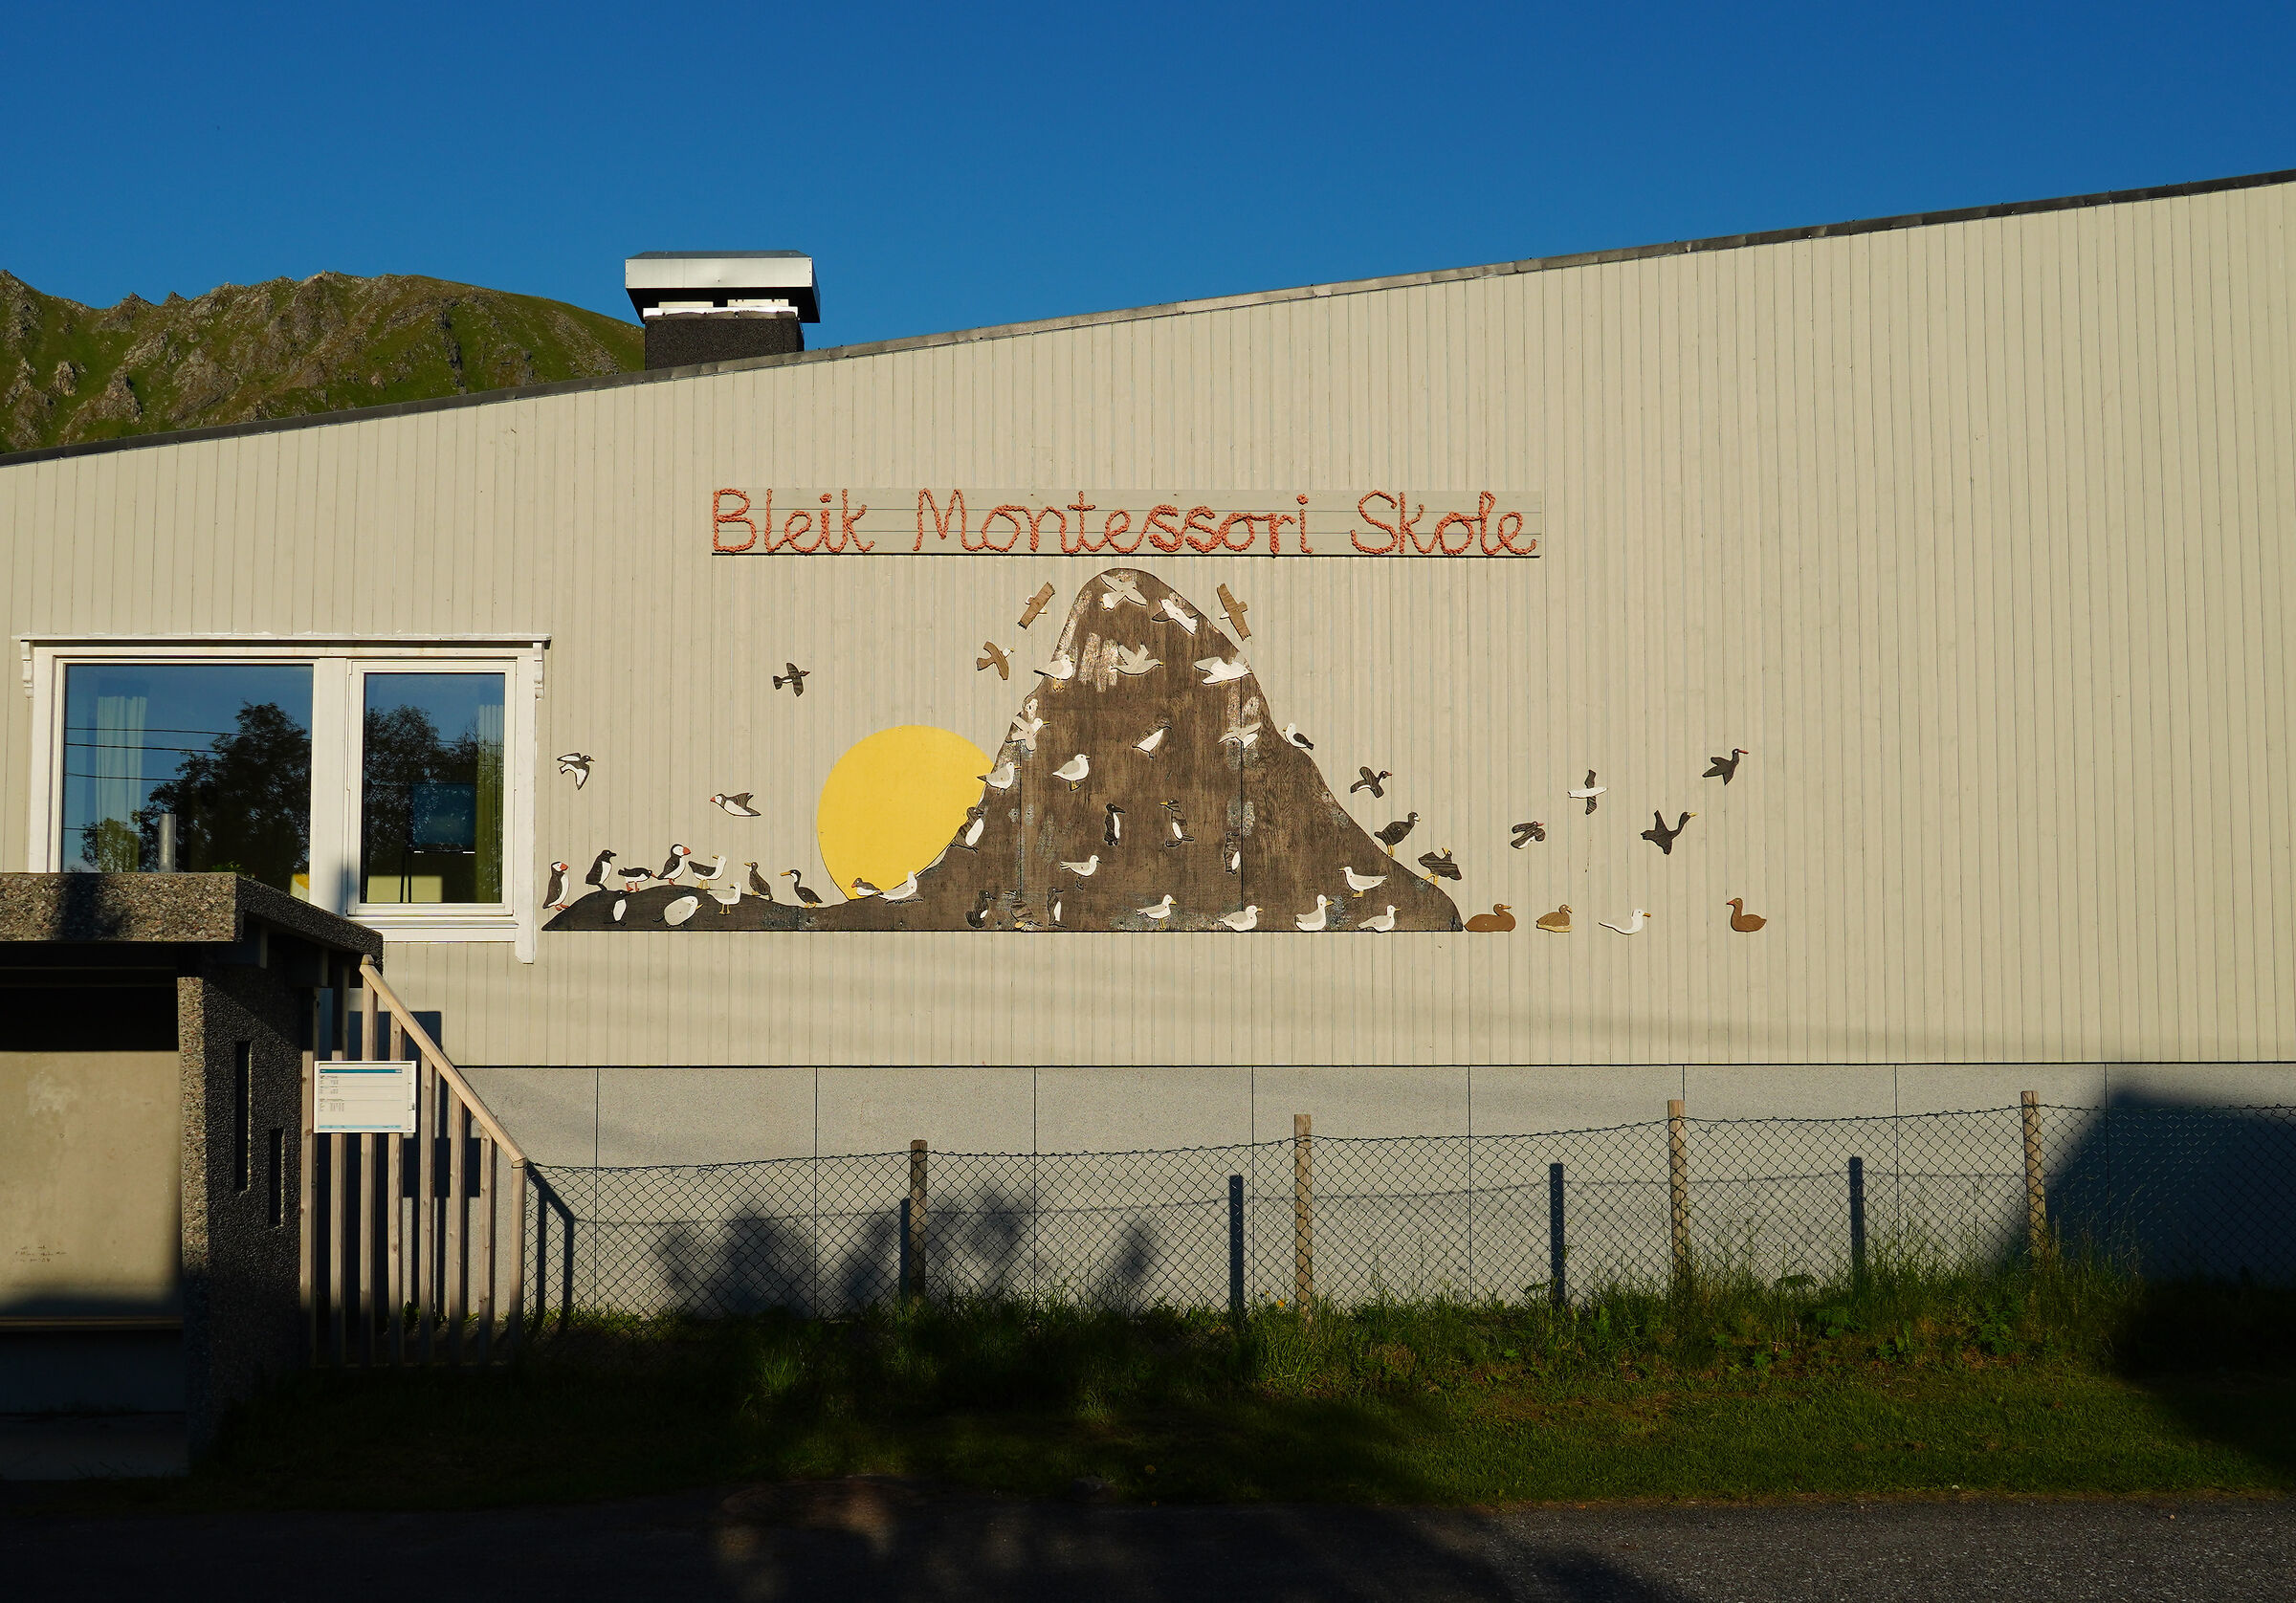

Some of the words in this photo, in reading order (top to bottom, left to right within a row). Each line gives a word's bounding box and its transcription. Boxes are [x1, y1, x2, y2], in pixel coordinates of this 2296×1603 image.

[713, 488, 875, 553] Bleik
[913, 488, 1314, 554] Montessori
[1350, 490, 1536, 555] Skole
